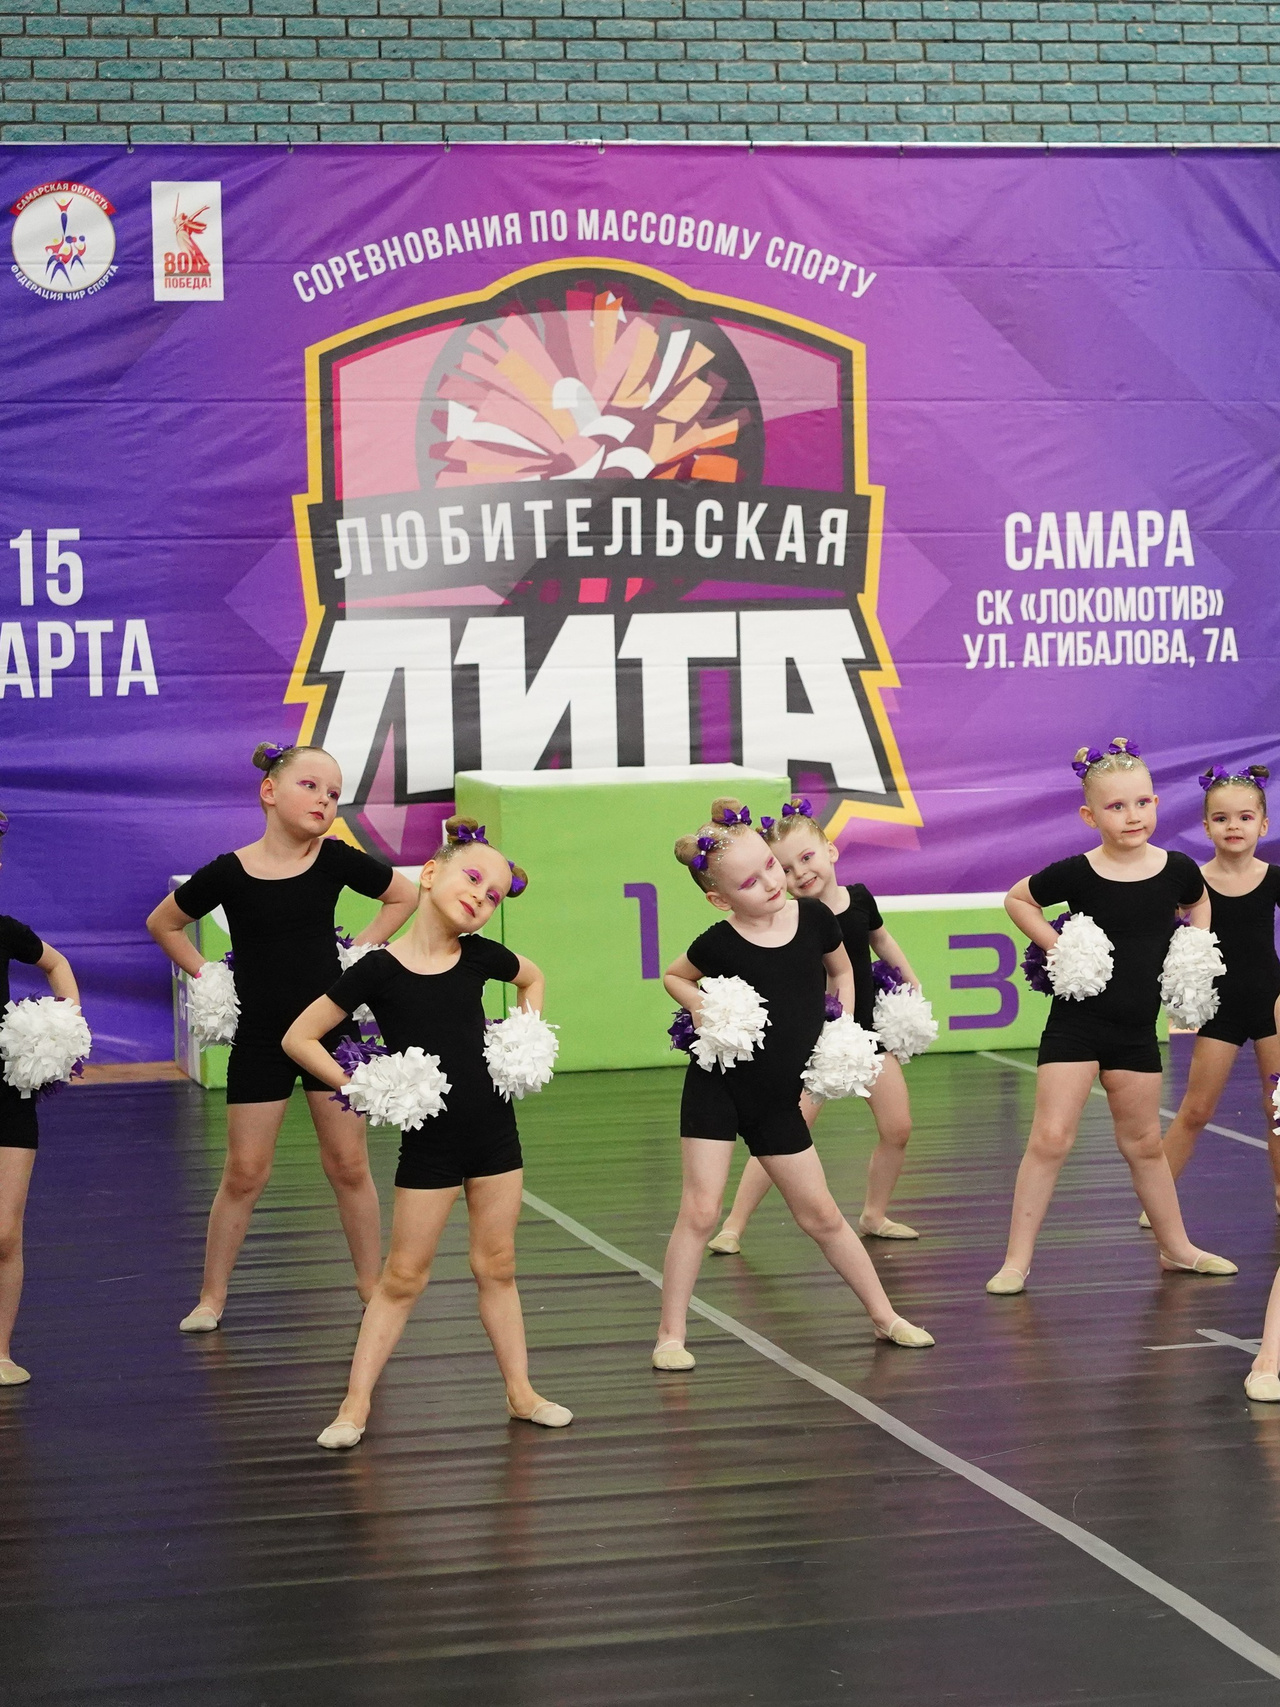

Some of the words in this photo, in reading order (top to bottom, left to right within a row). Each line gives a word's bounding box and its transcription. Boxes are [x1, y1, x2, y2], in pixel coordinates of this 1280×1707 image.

[16, 183, 69, 210] САМАРСКАЯ
[71, 184, 108, 210] ОБЛАСТЬ
[11, 264, 63, 300] ФЕДЕРАЦИЯ
[65, 290, 85, 300] ЧИР
[87, 264, 118, 295] СПОРТА
[164, 252, 189, 274] 80
[164, 277, 212, 289] ПОБЕДА!
[292, 212, 522, 303] СОРЕВНОВАНИЯ
[530, 209, 569, 243] ПО
[577, 208, 761, 261] МАССОВОМУ
[765, 235, 877, 299] СПОРТУ
[9, 528, 84, 606] 15
[333, 497, 849, 580] ЛЮБИТЕЛЬСКАЯ
[1004, 509, 1196, 571] САМАРА
[976, 588, 1014, 626] СК
[1020, 585, 1224, 624] «ЛОКОМОТИВ»
[0, 619, 160, 699] АРТА
[962, 632, 1016, 670] УЛ.
[1022, 628, 1196, 669] АГИБАЛОВА,
[1202, 627, 1239, 663] 7А
[319, 608, 887, 804] ЛИГА
[623, 882, 660, 980] 1
[948, 933, 1019, 1030] 3
